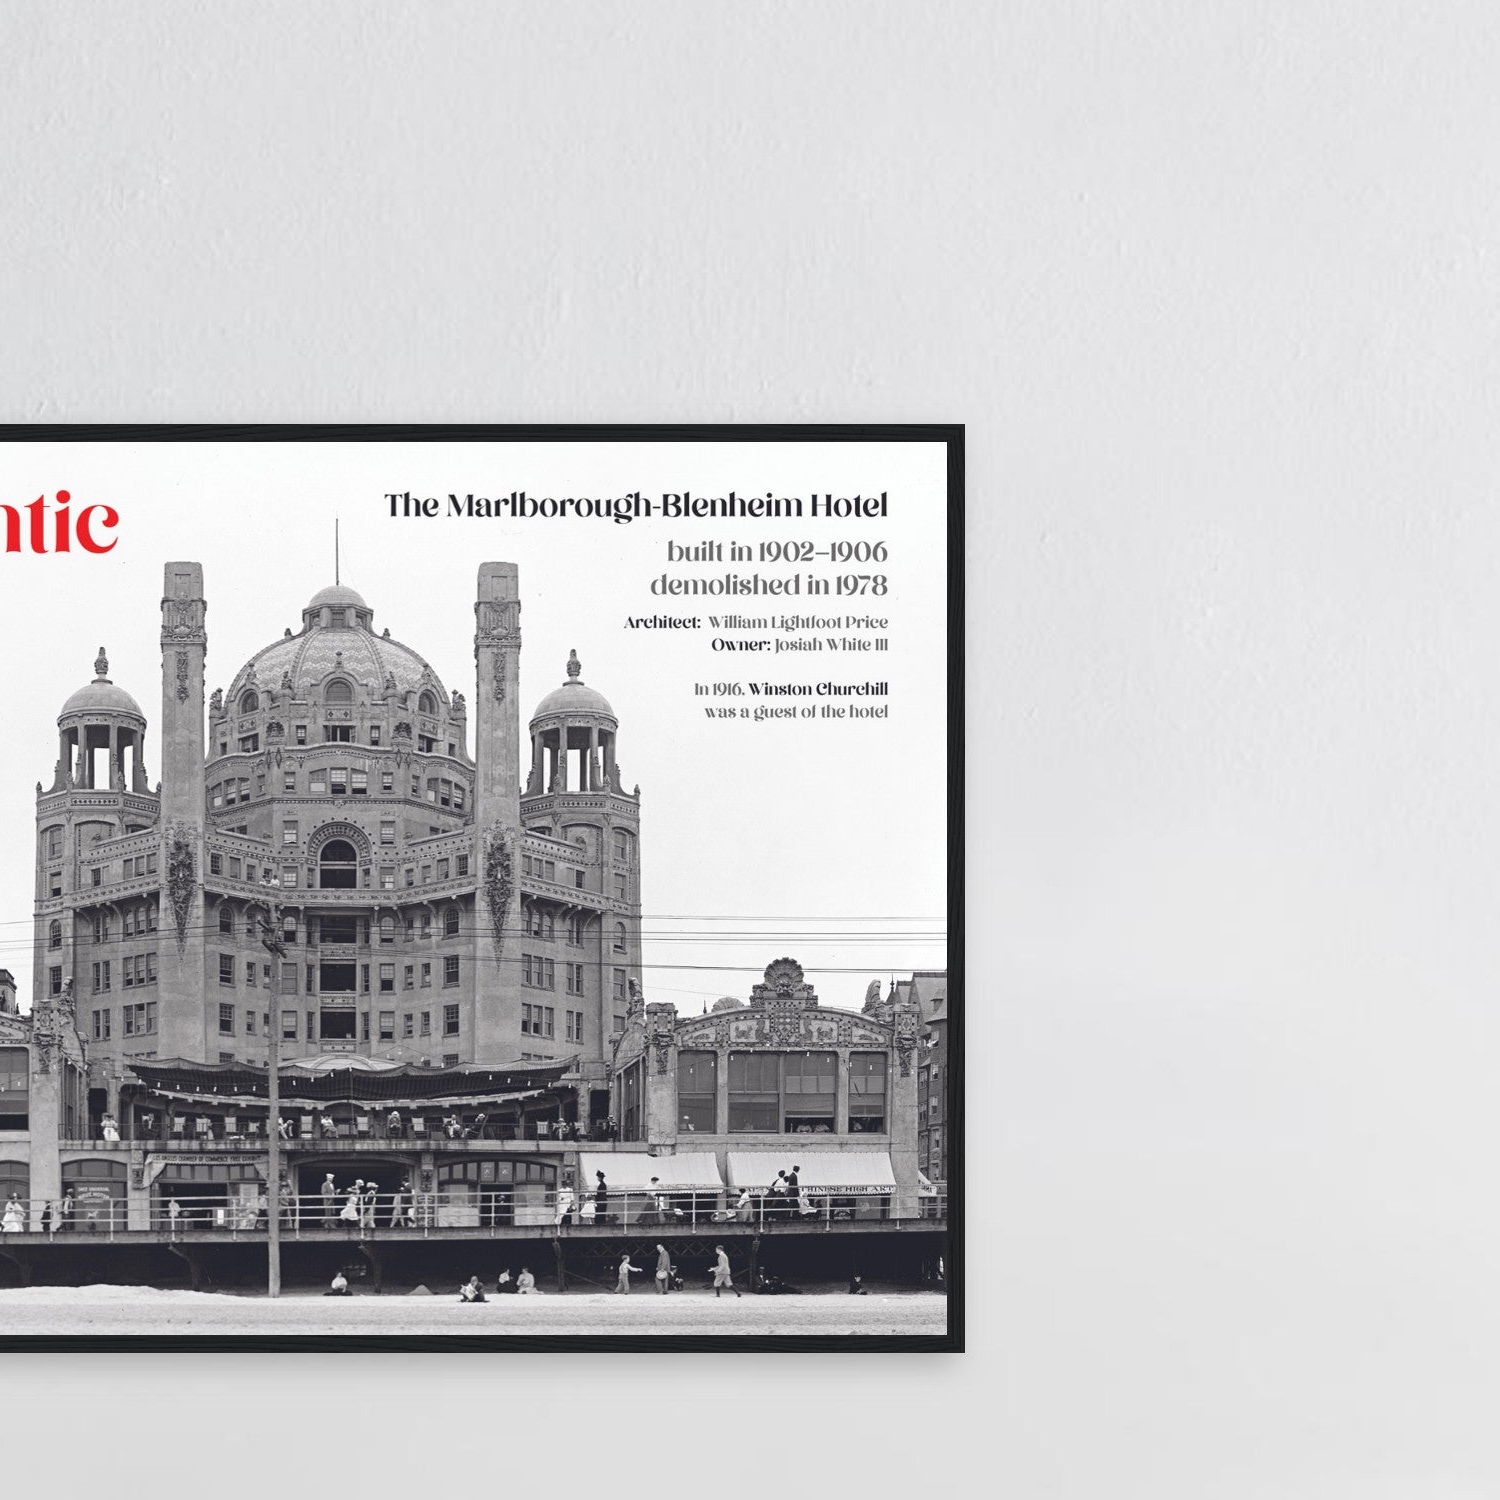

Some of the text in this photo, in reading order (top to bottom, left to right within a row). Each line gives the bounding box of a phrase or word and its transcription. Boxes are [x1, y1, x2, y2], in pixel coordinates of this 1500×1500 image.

[384, 491, 888, 525] The Marlborough-Blenheim Hotel
[668, 540, 723, 562] built
[731, 541, 753, 562] in
[651, 573, 888, 596] demolished in 1978
[624, 615, 888, 632] Architect: William Lightfoot Price
[712, 638, 771, 652] Owner:
[775, 637, 822, 654] Josiah
[826, 637, 871, 652] White
[695, 682, 709, 696] In
[748, 682, 812, 697] Winston
[816, 682, 888, 697] Churchill
[705, 704, 888, 722] was a guest of the hotel
